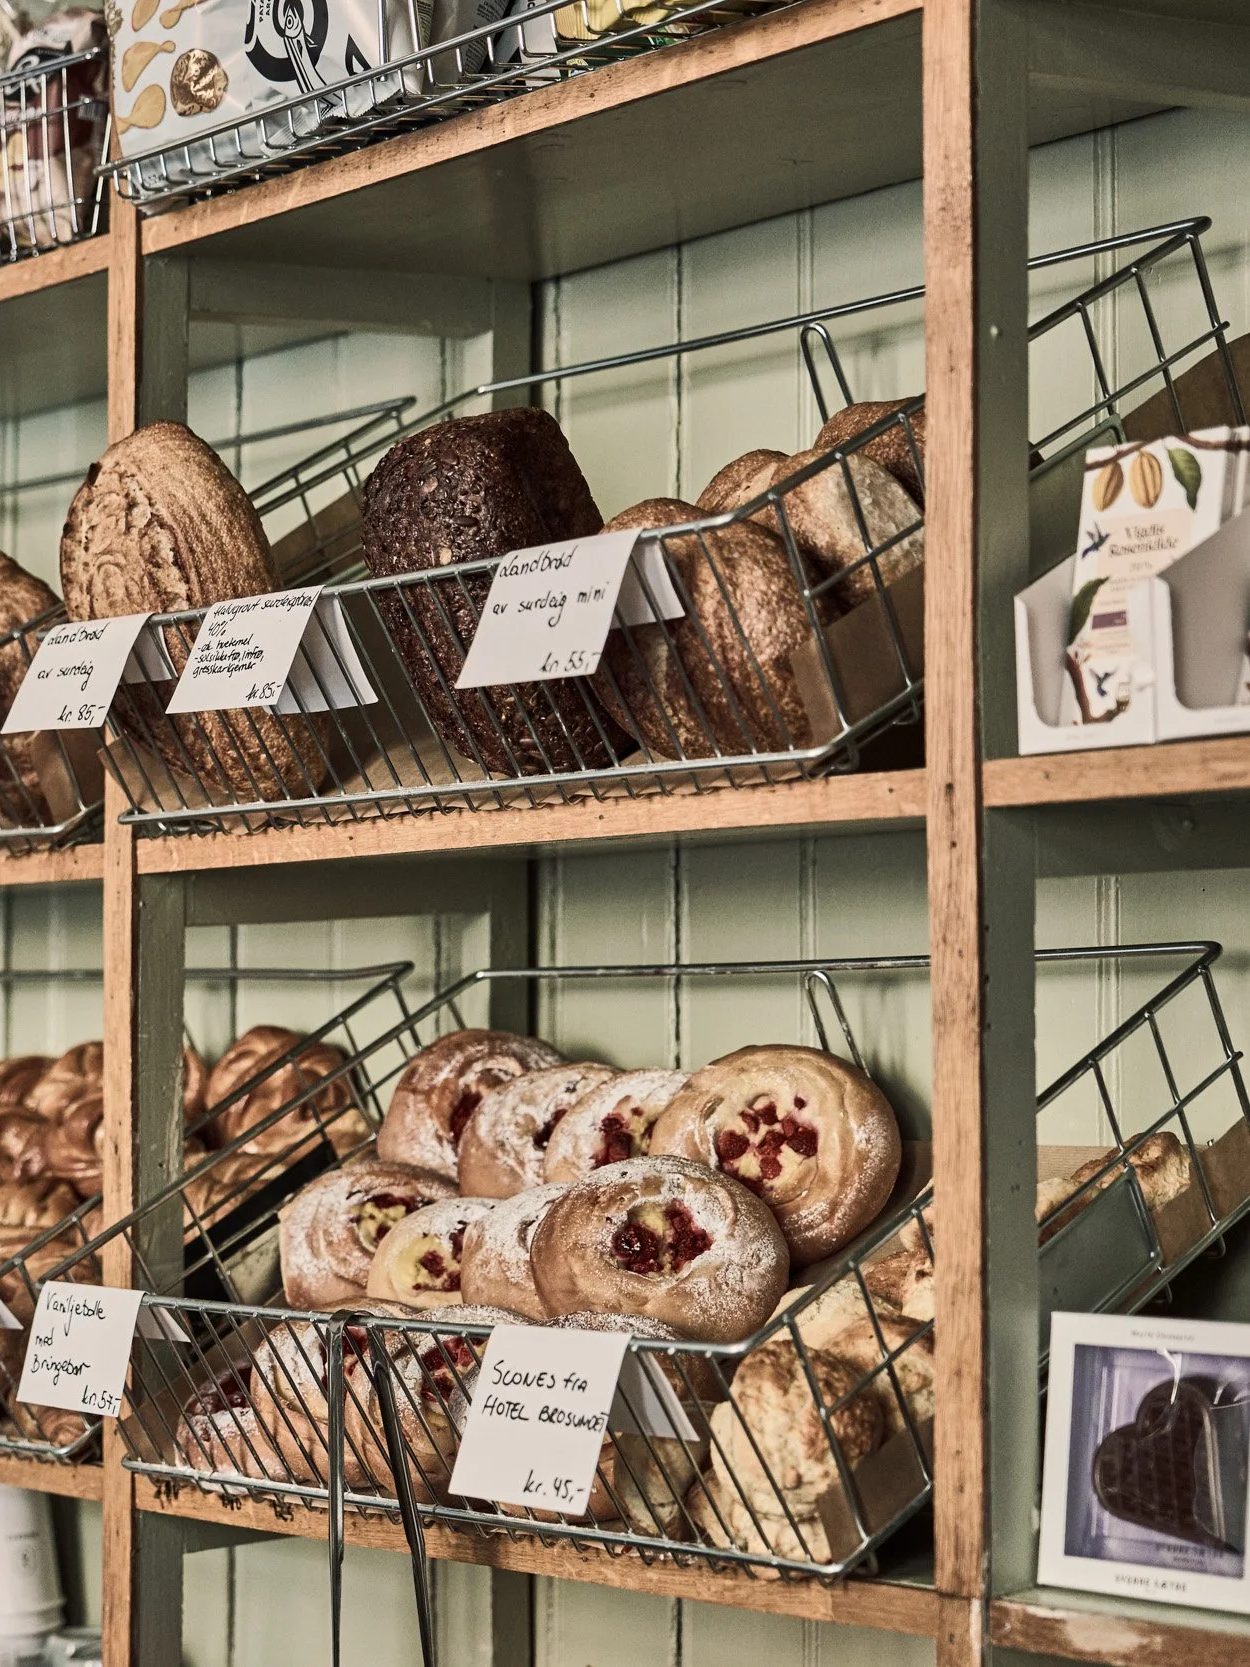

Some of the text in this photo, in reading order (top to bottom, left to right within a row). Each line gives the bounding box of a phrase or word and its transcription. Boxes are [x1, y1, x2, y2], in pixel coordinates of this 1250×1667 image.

[500, 545, 578, 577] Landbrød
[492, 580, 610, 628] av surdeig mini
[208, 620, 228, 638] 40%
[564, 650, 602, 671] 55,-
[37, 660, 94, 692] av surdeig
[77, 703, 106, 726] 85,-
[46, 1292, 106, 1337] Vaniljebolle
[34, 1327, 55, 1347] med
[493, 1360, 556, 1390] SCONES
[482, 1394, 530, 1421] HOTEL
[522, 1469, 586, 1503] kr. 45,-
